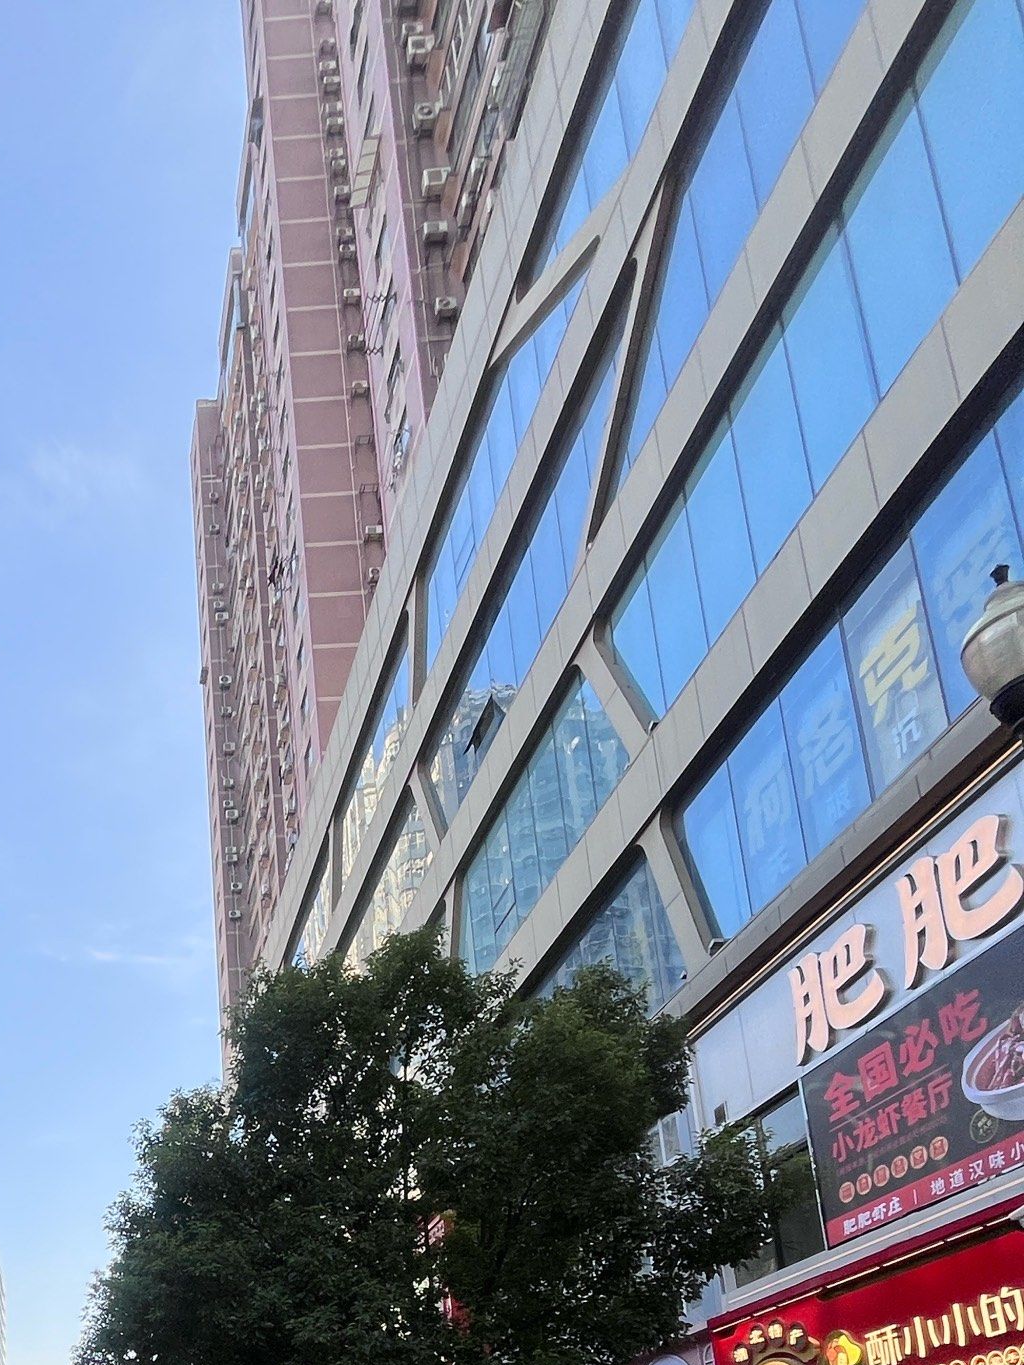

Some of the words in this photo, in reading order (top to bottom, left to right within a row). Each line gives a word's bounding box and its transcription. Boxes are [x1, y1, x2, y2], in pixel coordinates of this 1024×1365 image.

[787, 815, 1024, 1066] 肥肥
[824, 989, 987, 1122] 全国必吃
[832, 1072, 953, 1163] 小龙虾餐厅
[843, 1196, 903, 1236] 肥肥虾庄
